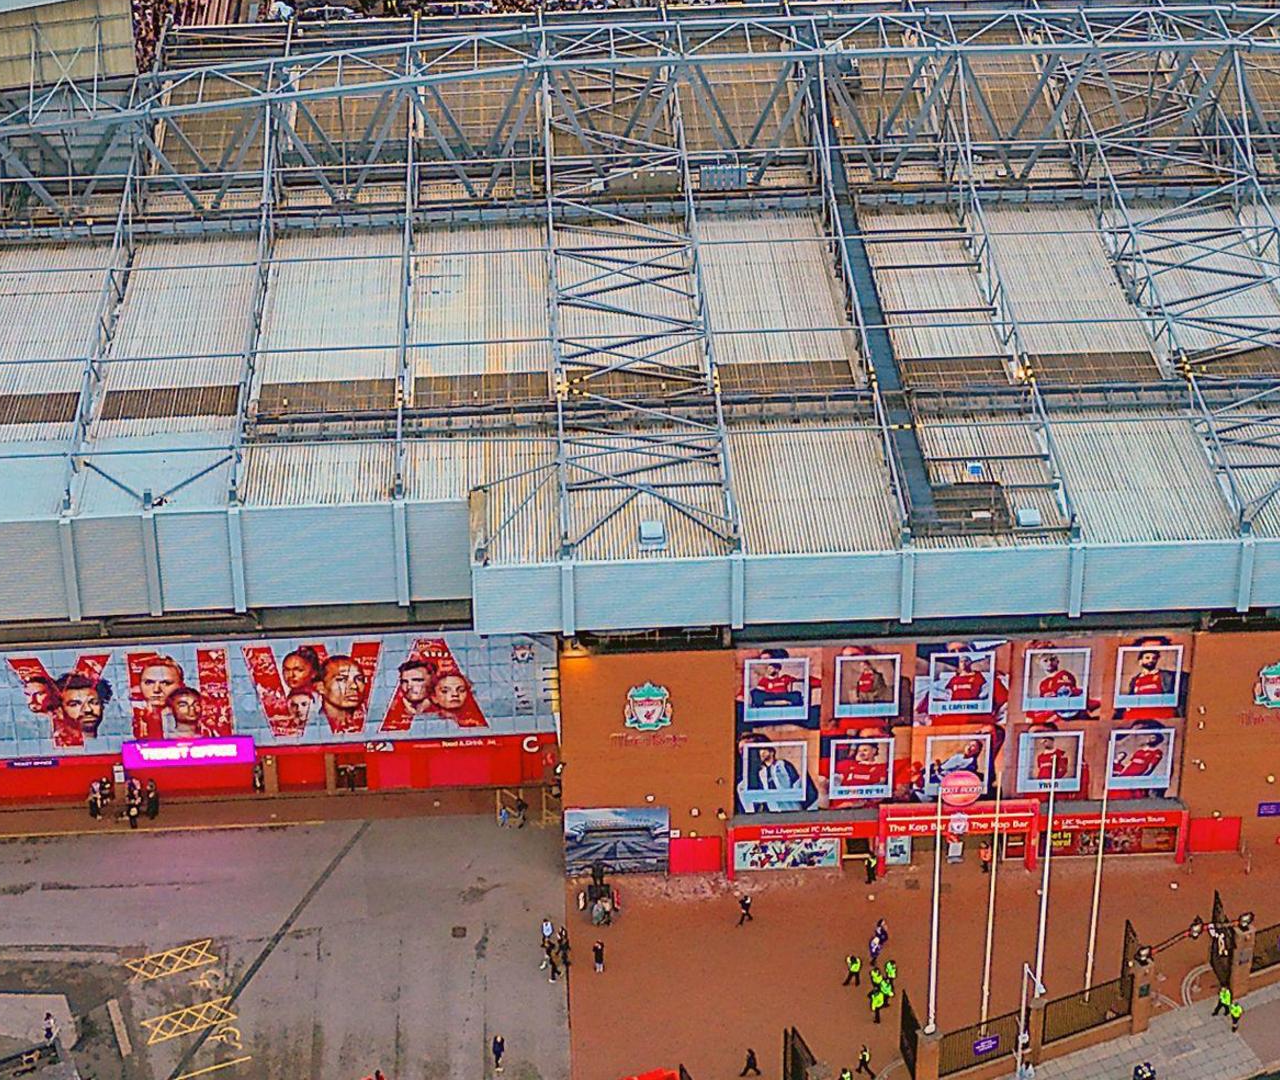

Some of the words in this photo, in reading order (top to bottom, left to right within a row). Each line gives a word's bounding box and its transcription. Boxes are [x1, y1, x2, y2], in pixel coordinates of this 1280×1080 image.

[522, 736, 539, 753] C
[888, 824, 906, 832] The
[908, 823, 928, 832] Kop
[1012, 820, 1029, 828] Bar
[776, 827, 810, 835] Liverpool
